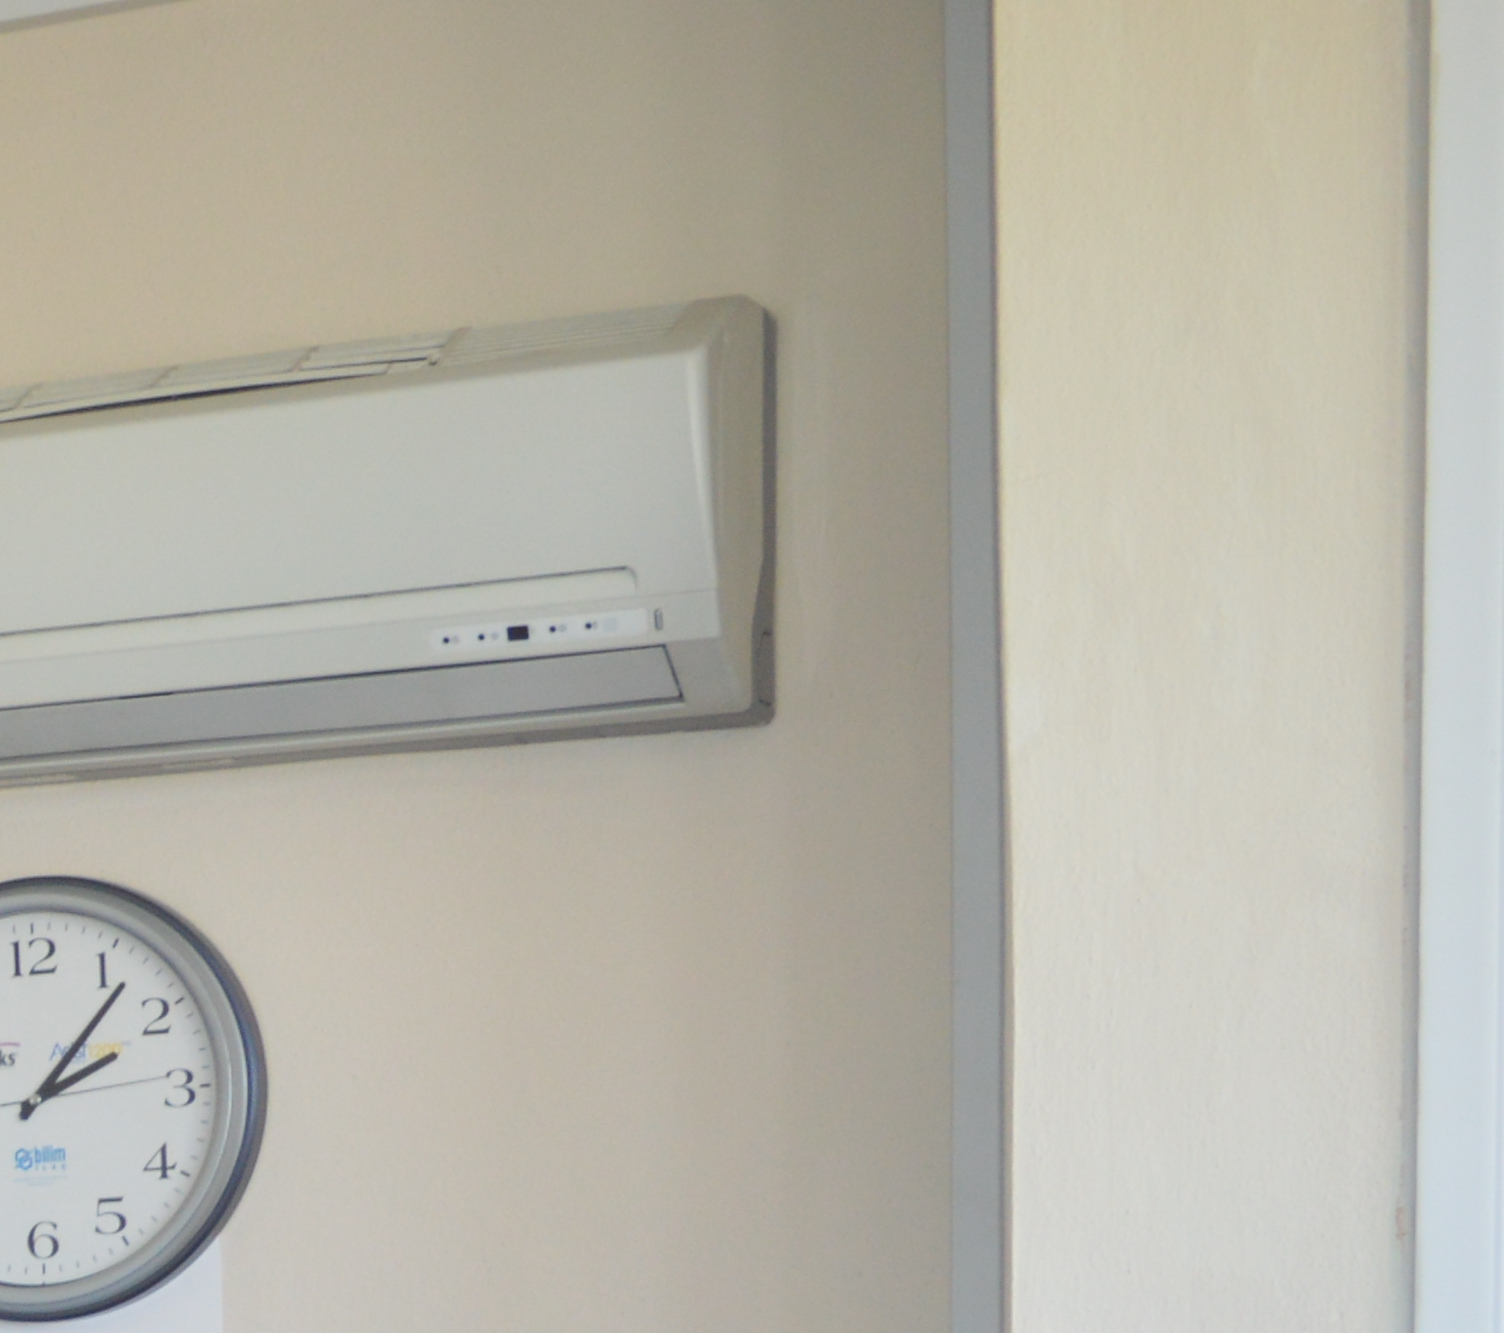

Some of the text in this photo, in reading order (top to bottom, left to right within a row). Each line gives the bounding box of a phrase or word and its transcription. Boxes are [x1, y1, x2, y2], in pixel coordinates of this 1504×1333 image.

[11, 937, 58, 978] 12
[96, 951, 109, 988] 1
[141, 997, 171, 1035] 2
[163, 1069, 195, 1107] 3
[35, 1145, 66, 1163] bilim
[143, 1143, 177, 1179] 4
[94, 1197, 127, 1235] 5
[27, 1221, 59, 1259] 6
